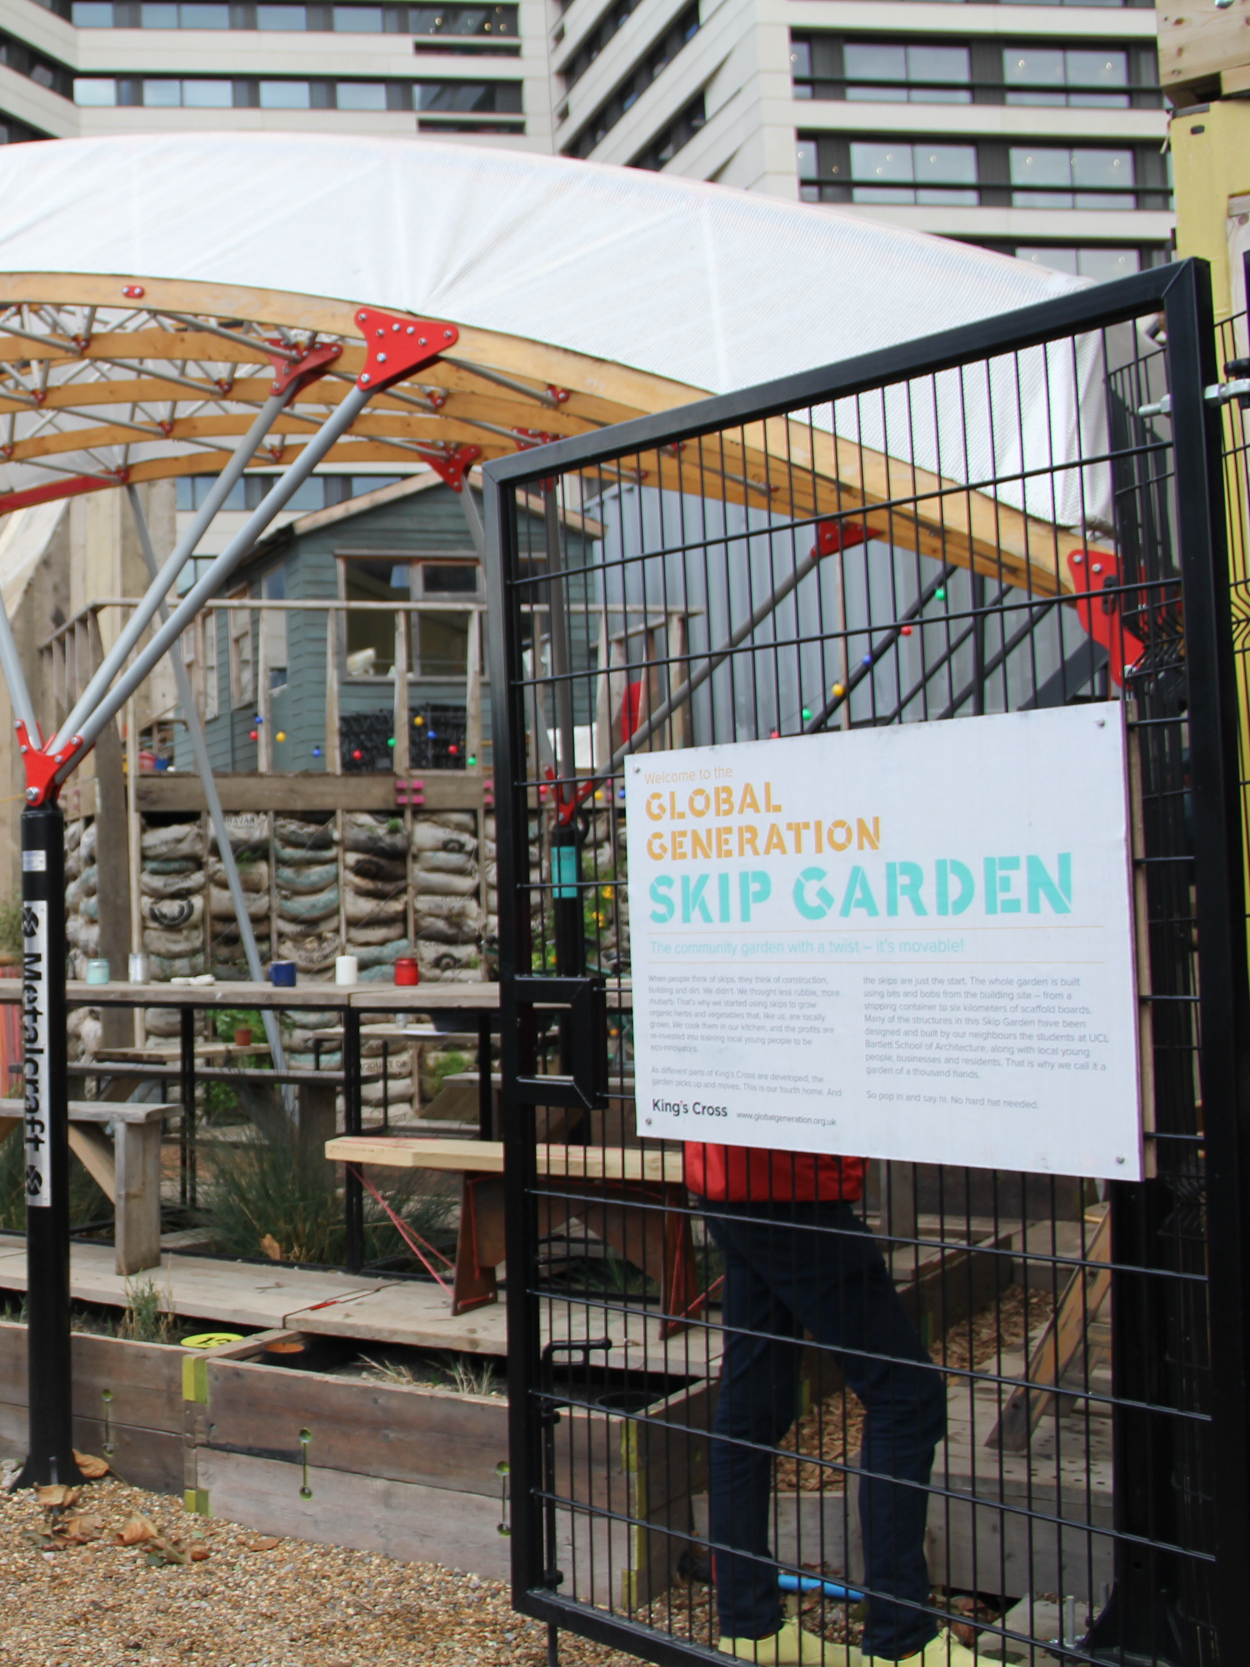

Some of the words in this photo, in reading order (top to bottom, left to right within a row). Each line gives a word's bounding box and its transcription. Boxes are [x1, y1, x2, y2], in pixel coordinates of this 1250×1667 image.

[645, 770, 696, 784] Welcome
[699, 768, 710, 780] to
[714, 766, 732, 779] the
[645, 781, 782, 821] GLOBAL
[645, 815, 880, 861] GENERATION
[648, 870, 772, 924] SKIP
[791, 852, 1072, 921] GARDEN
[651, 941, 672, 954] The
[674, 940, 737, 957] community
[740, 940, 785, 957] garden
[787, 940, 814, 953] with
[817, 943, 825, 953] a
[828, 939, 860, 953] twist
[876, 939, 895, 952] it's
[898, 939, 965, 952] movable!
[667, 975, 690, 983] people
[877, 977, 898, 986] skips
[914, 977, 929, 986] just
[931, 977, 945, 985] the
[970, 977, 986, 985] The
[1016, 978, 1049, 987] garden
[648, 987, 673, 996] building
[749, 988, 776, 997] thought
[863, 989, 885, 999] using
[919, 990, 941, 998] bobs
[942, 990, 961, 998] from
[963, 990, 978, 998] the
[979, 991, 1015, 1000] building
[1016, 991, 1032, 999] site
[1042, 991, 1064, 999] from
[864, 1002, 897, 1013] shipping
[898, 1003, 937, 1011] container
[962, 1004, 1007, 1012] kilometers
[1020, 1005, 1056, 1013] scaffold
[864, 1015, 885, 1025] Many
[887, 1015, 895, 1023] of
[896, 1015, 910, 1023] the
[912, 1016, 952, 1024] structures
[964, 1017, 980, 1025] this
[981, 1017, 1000, 1027] Skip
[1002, 1018, 1035, 1026] Garden
[1037, 1019, 1060, 1027] have
[1062, 1019, 1086, 1027] been
[864, 1028, 901, 1038] designed
[903, 1029, 919, 1037] and
[920, 1029, 938, 1037] built
[939, 1030, 950, 1039] by
[968, 1031, 1017, 1041] neighbours
[1019, 1032, 1034, 1040] the
[1036, 1033, 1075, 1041] students
[1077, 1034, 1087, 1042] at
[1088, 1034, 1109, 1042] UCL
[23, 953, 47, 1154] Metalcraft
[864, 1040, 893, 1048] Bartlett
[894, 1041, 923, 1049] School
[924, 1042, 934, 1050] of
[990, 1044, 1015, 1055] along
[1017, 1045, 1035, 1053] with
[1037, 1046, 1059, 1054] local
[1060, 1049, 1091, 1058] young
[896, 1055, 941, 1064] businesses
[943, 1056, 960, 1064] and
[1006, 1059, 1025, 1067] That
[1037, 1060, 1055, 1070] why
[1073, 1061, 1090, 1069] call
[1091, 1062, 1098, 1070] it
[660, 1066, 687, 1075] different
[688, 1068, 704, 1077] parts
[735, 1070, 755, 1079] Cross
[811, 1074, 824, 1082] the
[865, 1066, 893, 1077] garden
[894, 1067, 904, 1075] of
[912, 1068, 951, 1076] thousand
[651, 1078, 673, 1088] garden
[674, 1079, 692, 1089] picks
[703, 1081, 716, 1089] and
[743, 1083, 757, 1091] This
[779, 1085, 800, 1093] fourth
[826, 1088, 842, 1096] And
[866, 1091, 877, 1099] So
[878, 1093, 895, 1102] pop
[905, 1093, 921, 1101] and
[923, 1096, 937, 1104] say
[950, 1096, 964, 1104] No
[965, 1097, 985, 1105] hard
[986, 1098, 1001, 1106] hat
[652, 1099, 689, 1116] King's
[692, 1101, 728, 1117] Cross
[736, 1113, 837, 1126] www.globalgeneration.org.uk
